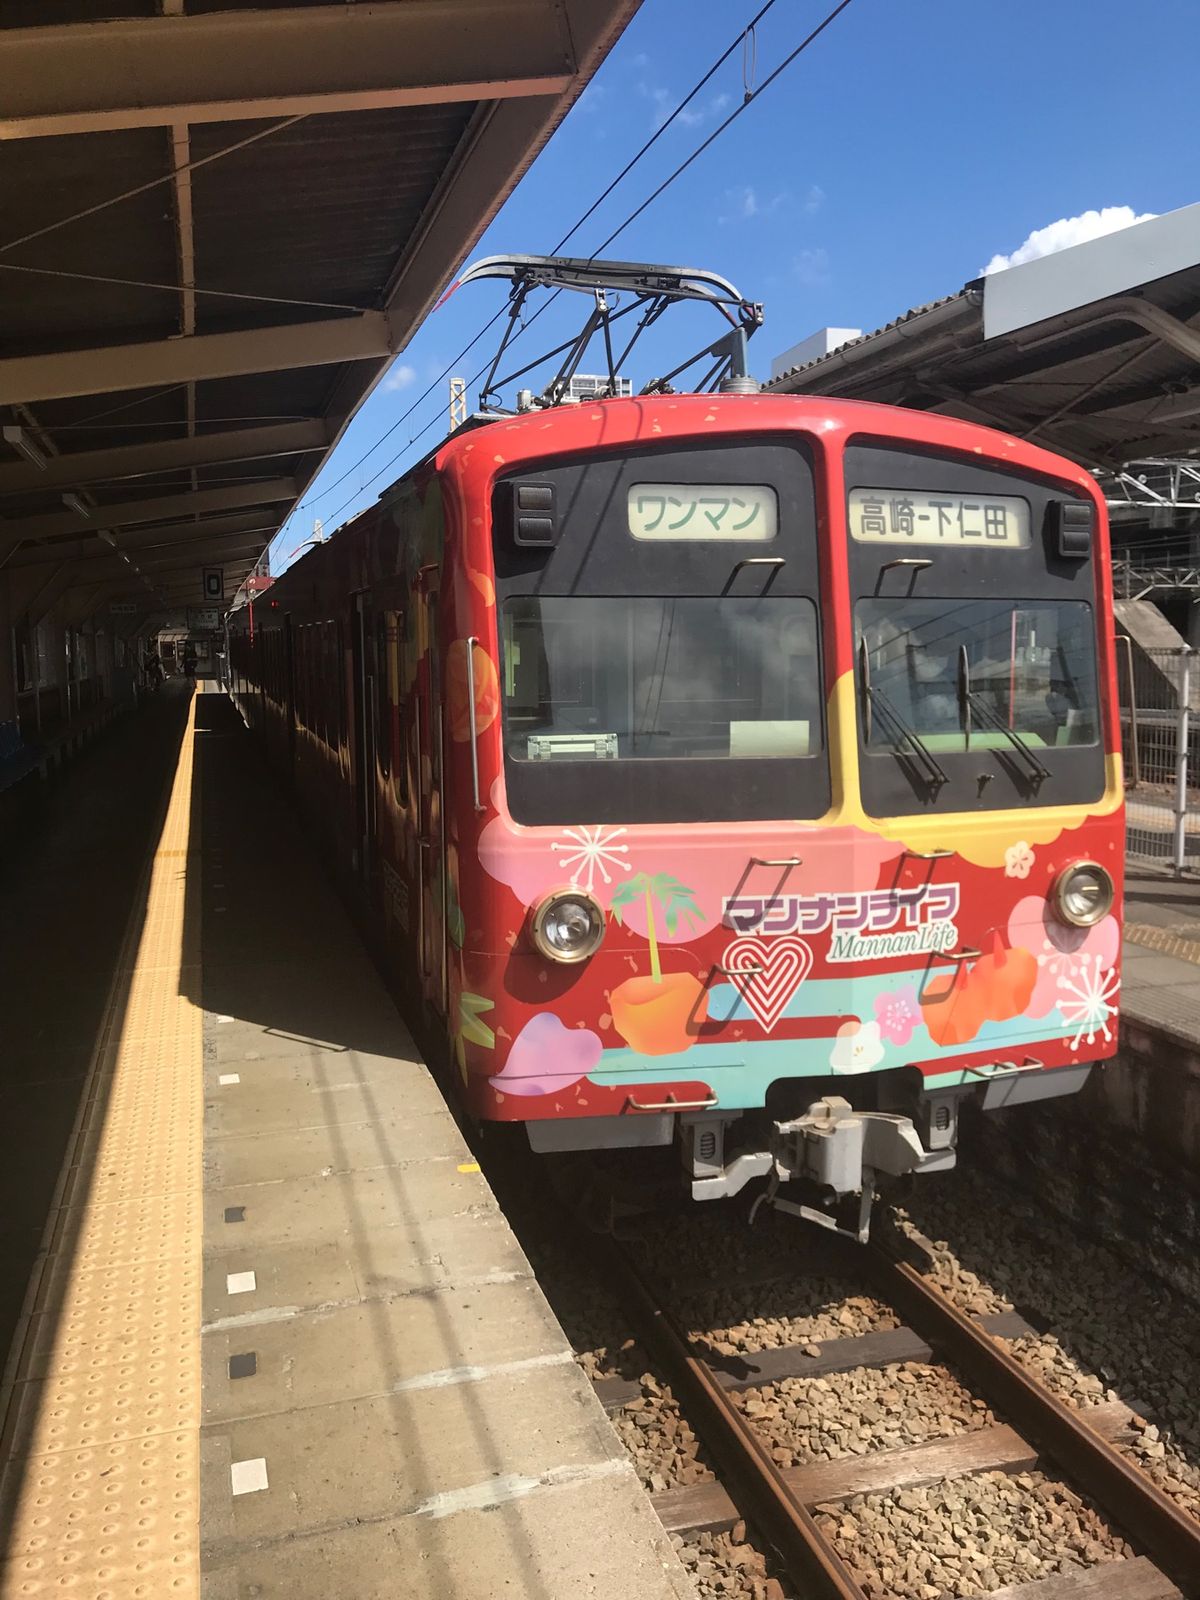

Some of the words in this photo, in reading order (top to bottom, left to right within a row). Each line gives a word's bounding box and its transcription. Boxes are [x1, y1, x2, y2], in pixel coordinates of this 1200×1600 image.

[637, 495, 761, 532] ワンマン
[725, 884, 959, 934] マンナンライフ
